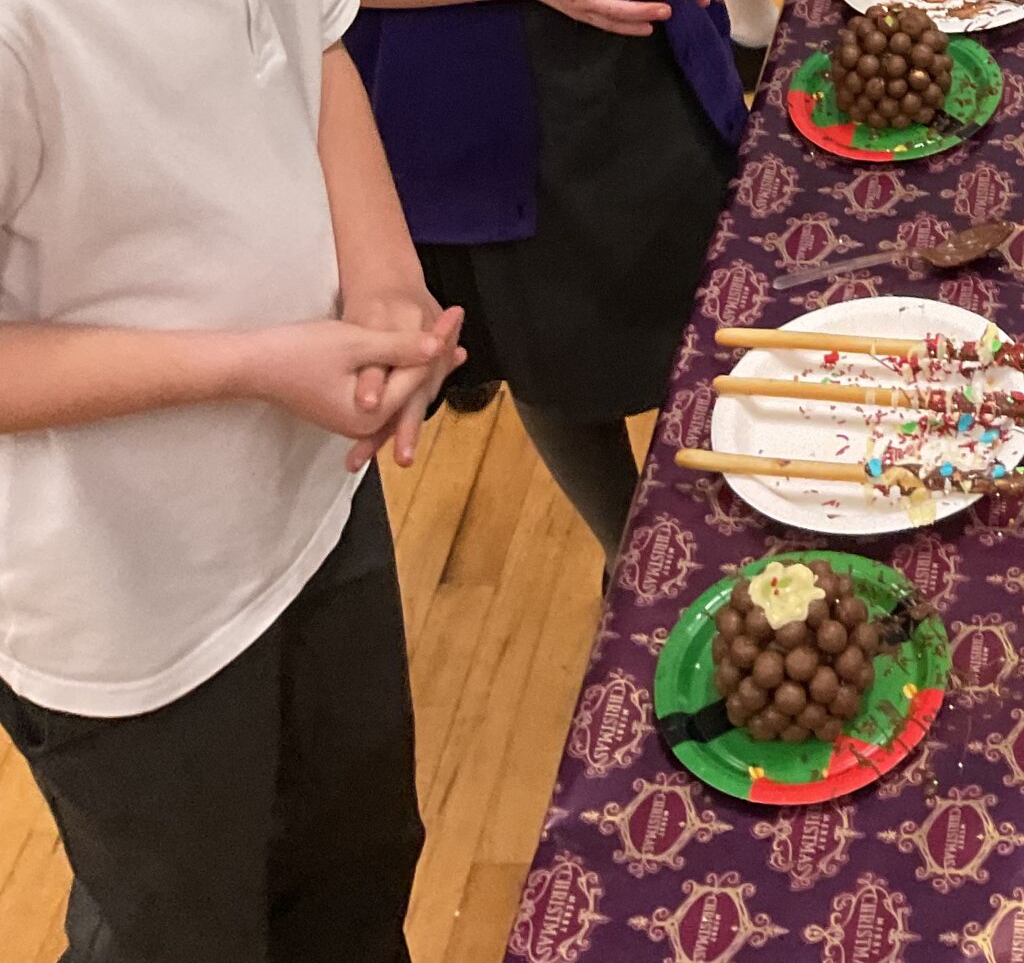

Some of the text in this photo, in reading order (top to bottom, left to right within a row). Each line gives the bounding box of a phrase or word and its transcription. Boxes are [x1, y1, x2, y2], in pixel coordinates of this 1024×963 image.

[641, 529, 671, 591] CHRISTMAS
[591, 687, 625, 759] CHRISTMAS
[534, 871, 573, 956] CHRISTMAS
